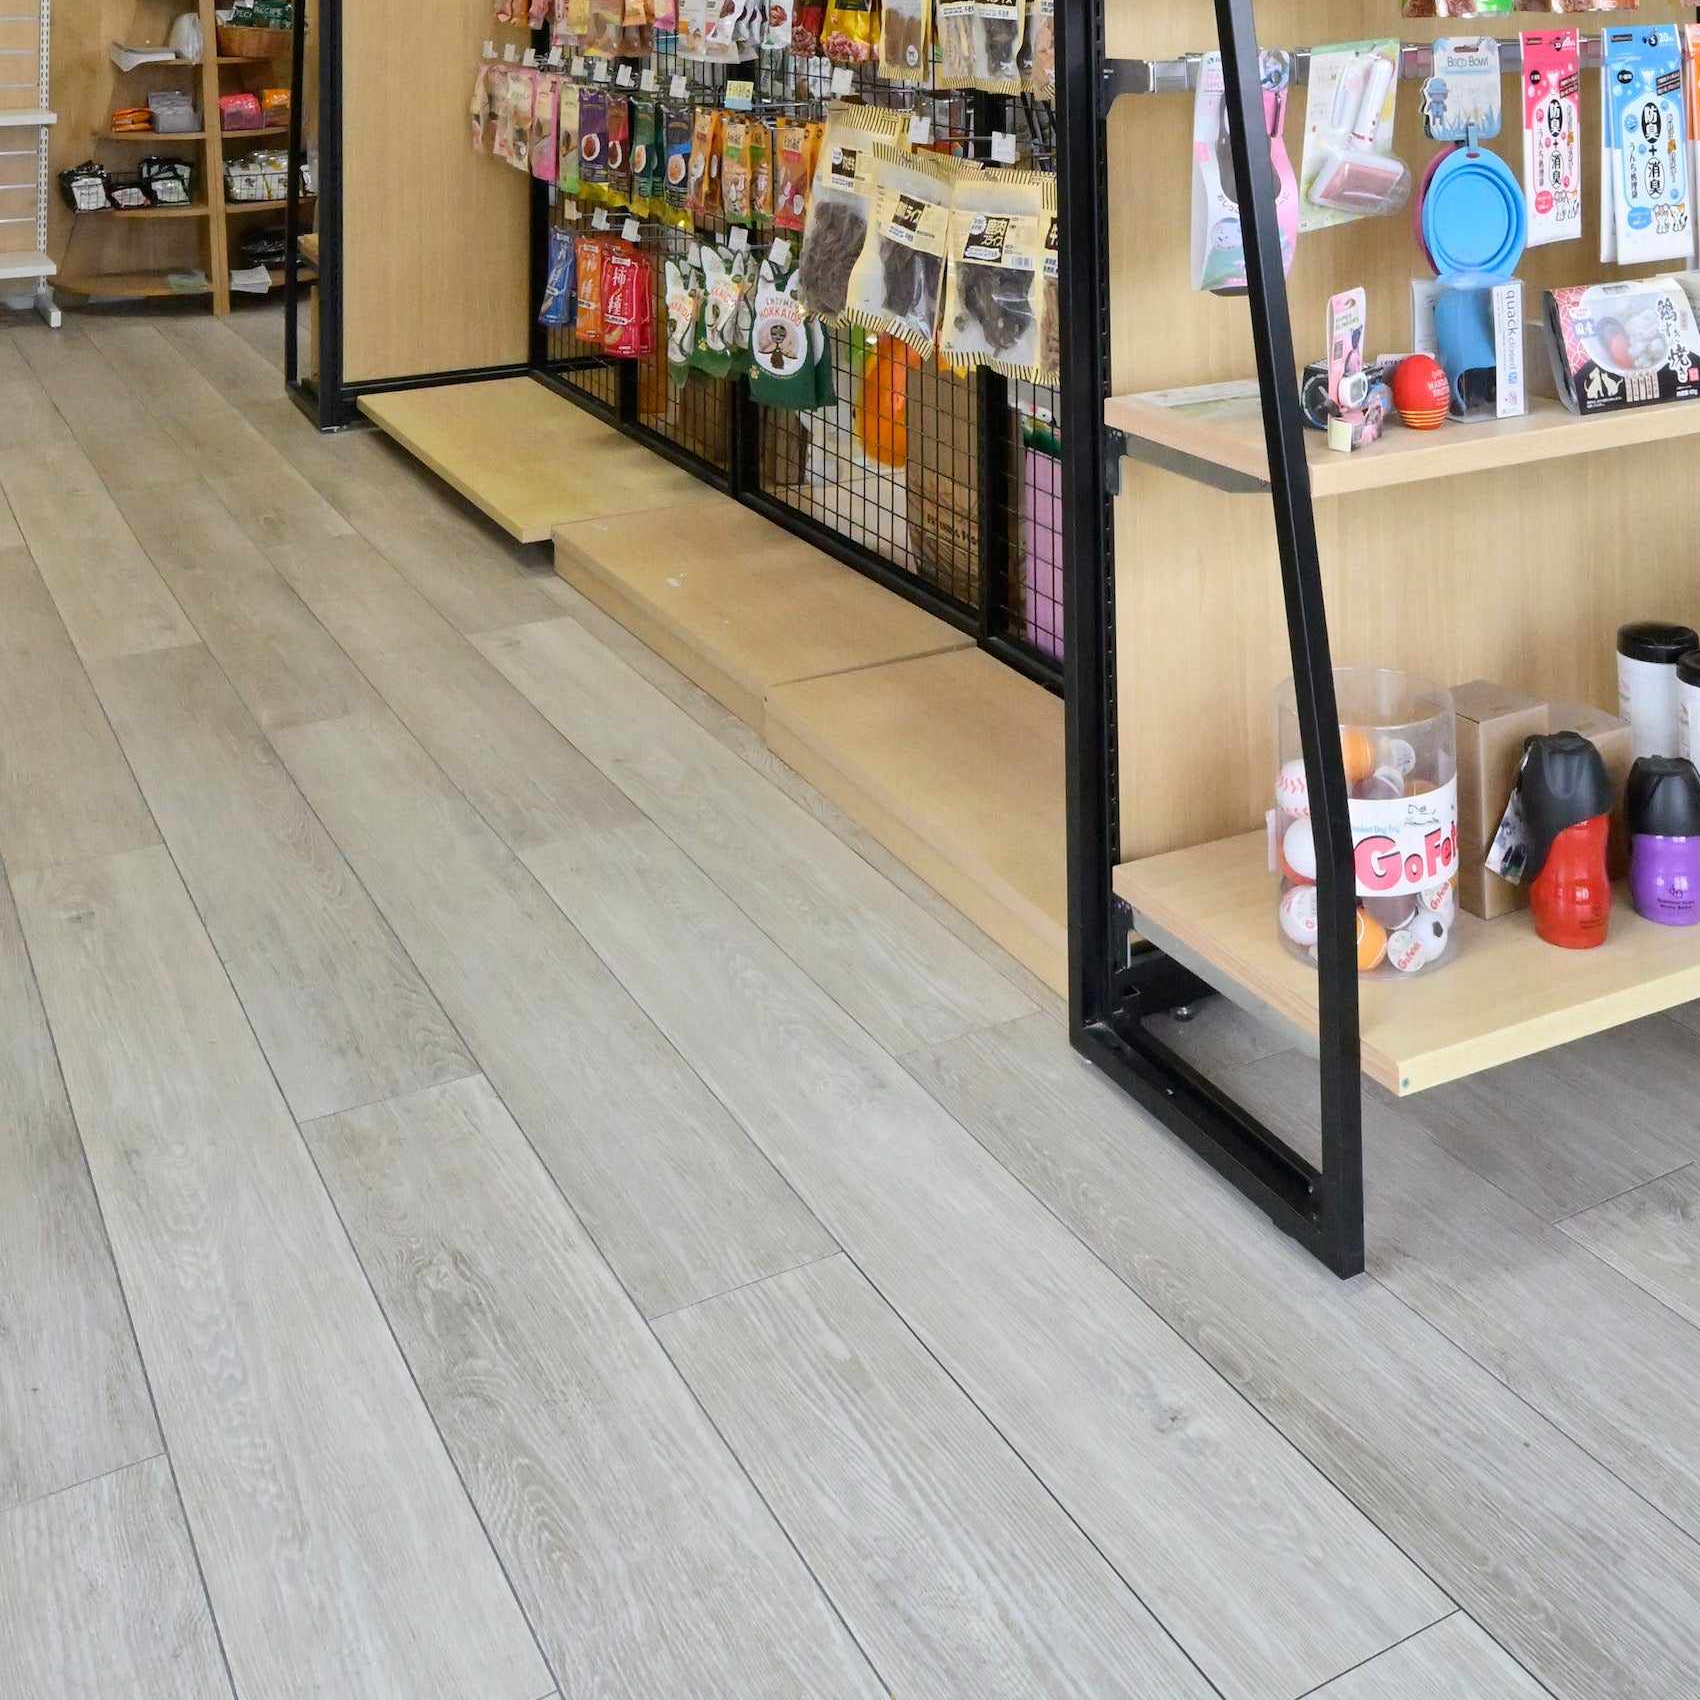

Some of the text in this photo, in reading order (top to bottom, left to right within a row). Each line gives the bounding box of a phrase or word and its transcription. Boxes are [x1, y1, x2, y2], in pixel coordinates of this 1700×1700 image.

[253, 5, 283, 16] RECIPE
[1469, 55, 1489, 68] Bowl
[1550, 101, 1562, 136] 防臭
[1644, 105, 1659, 142] 防臭
[1551, 153, 1563, 186] 消臭
[1647, 160, 1662, 196] 消臭
